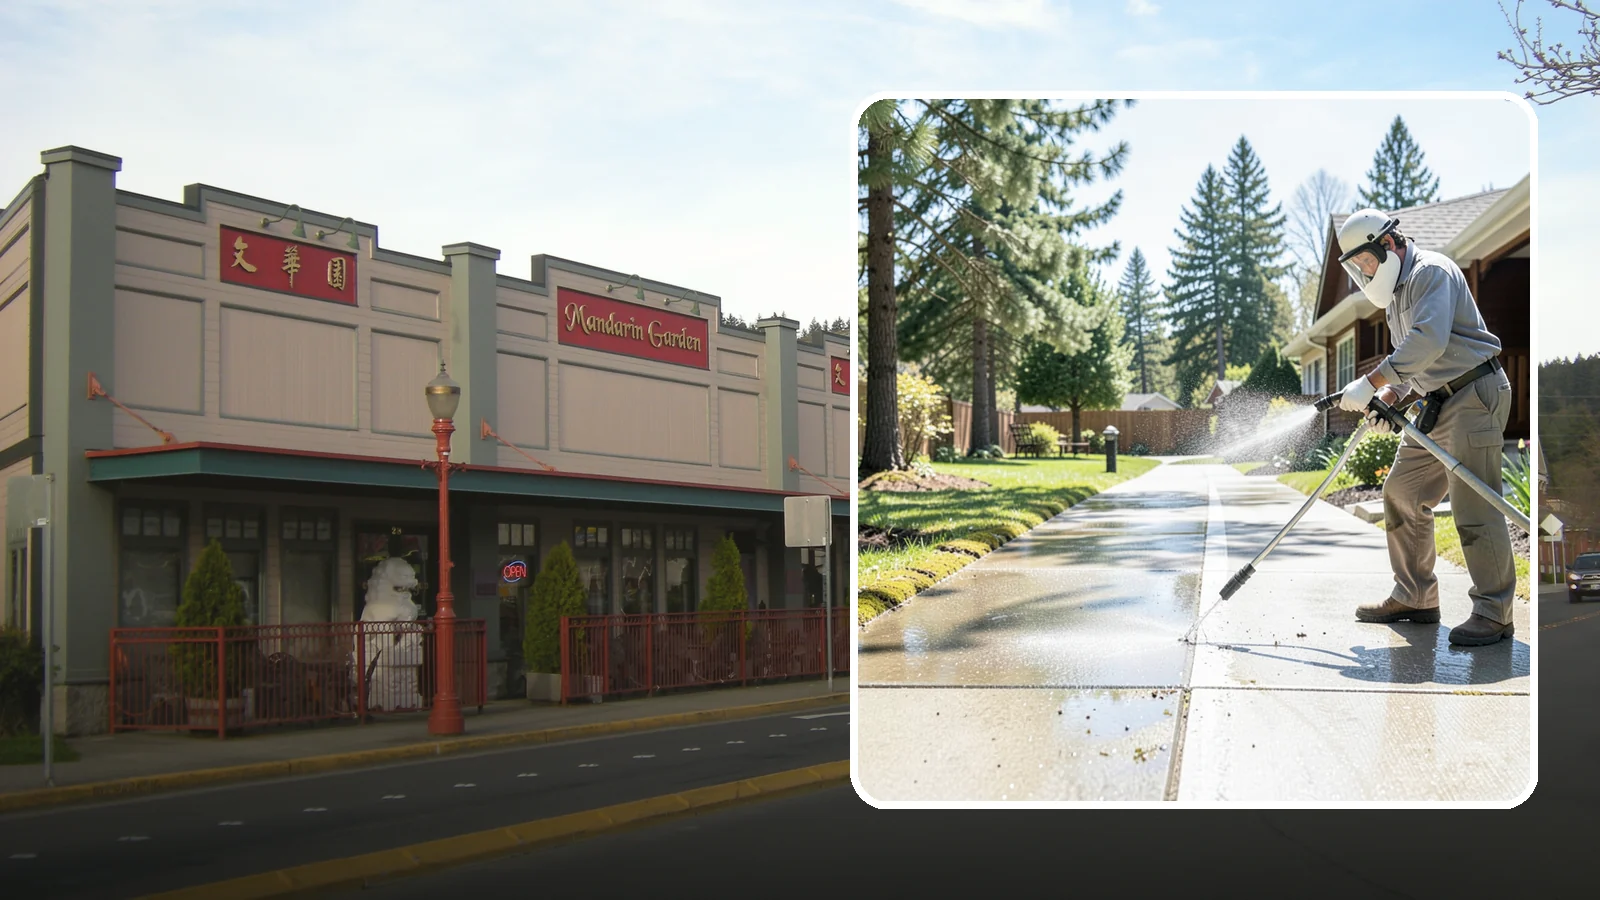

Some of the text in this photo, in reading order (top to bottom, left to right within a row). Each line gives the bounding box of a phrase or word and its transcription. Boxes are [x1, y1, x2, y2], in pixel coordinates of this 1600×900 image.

[231, 235, 346, 291] 文華園
[564, 302, 701, 352] Mandarin Garden
[503, 565, 527, 578] OPEN
